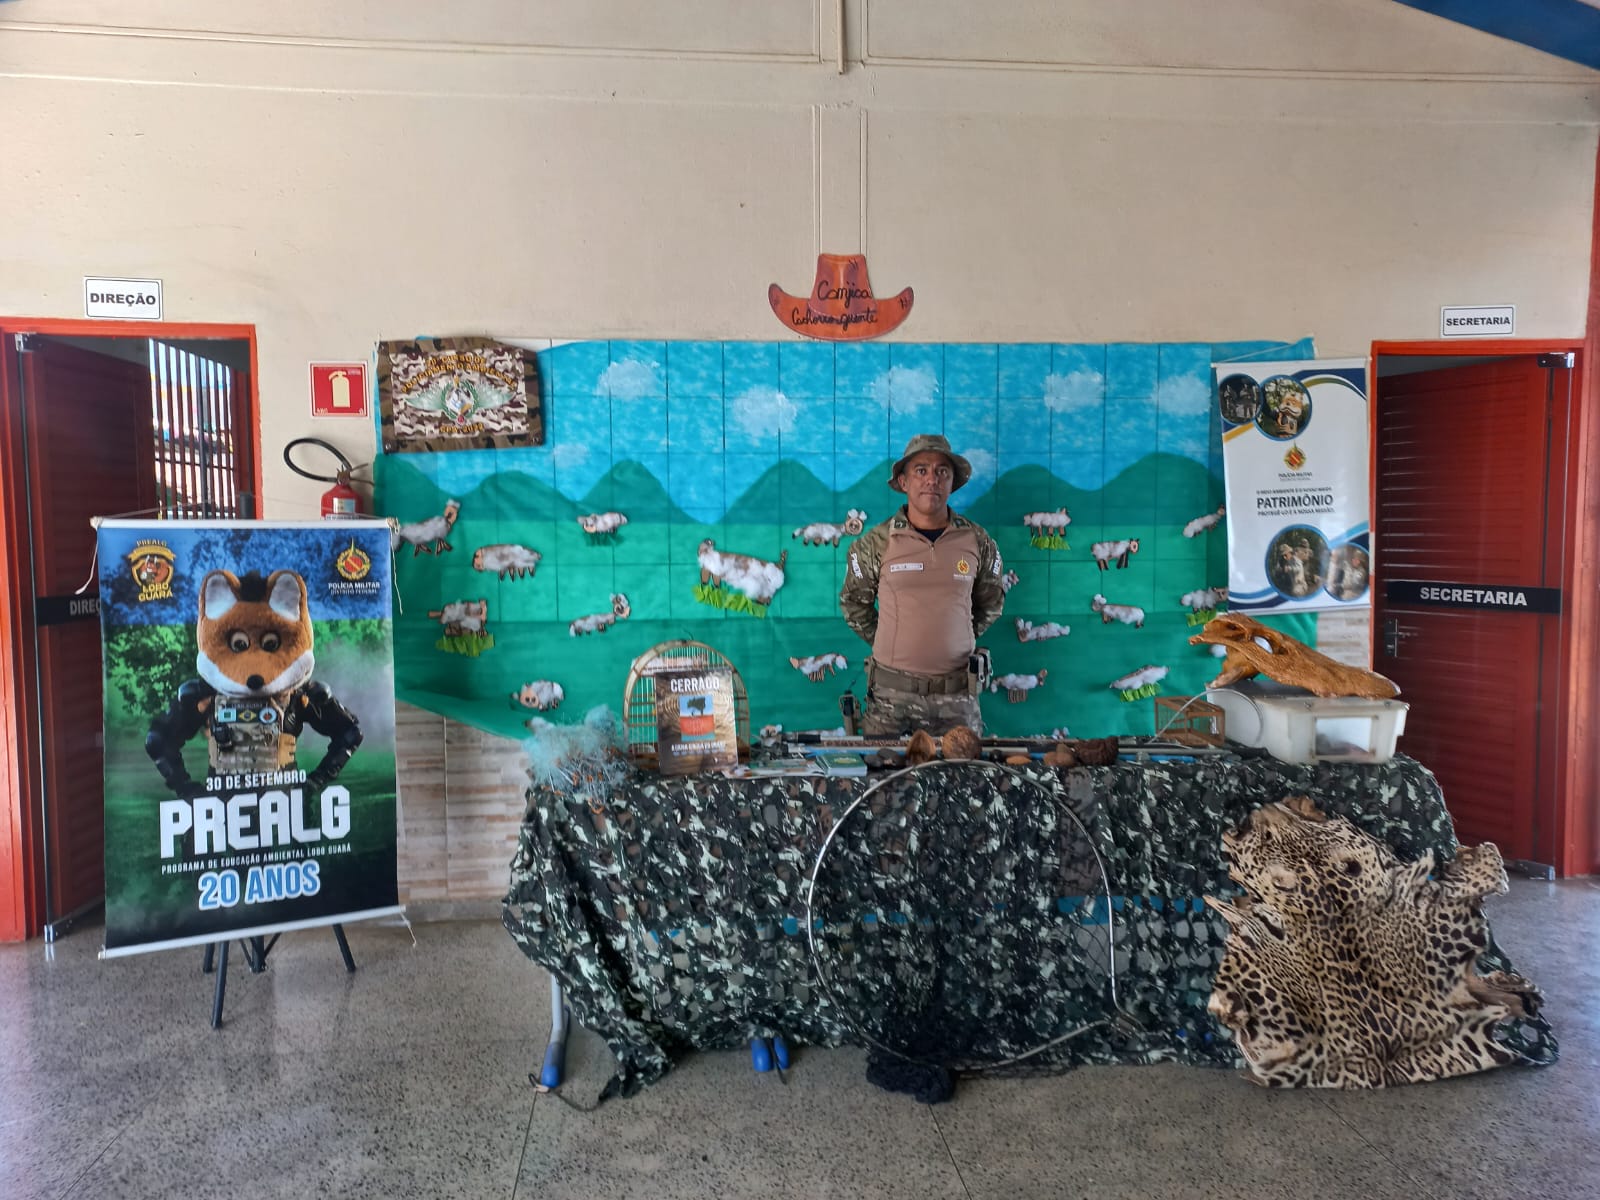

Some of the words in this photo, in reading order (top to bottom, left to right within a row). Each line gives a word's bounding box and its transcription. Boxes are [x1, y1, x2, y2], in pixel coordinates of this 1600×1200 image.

[89, 292, 156, 308] DIREÇÃO
[1445, 316, 1511, 327] SECRETARIA
[1256, 493, 1334, 509] PATRIMÔNIO
[327, 580, 354, 591] POLÍCIA
[354, 580, 380, 590] MILITAR
[1419, 586, 1528, 606] SECRETARIA
[670, 676, 720, 693] CERRADO
[206, 777, 222, 792] 30
[225, 775, 241, 790] DE
[244, 769, 307, 789] SETEMBRO
[159, 784, 351, 859] PREALG
[161, 860, 205, 875] PROGRAMA
[207, 858, 218, 869] DE
[220, 853, 261, 868] EDUCAÇÃO
[263, 848, 305, 863] AMBIENTAL
[307, 846, 326, 857] LOBO
[198, 869, 240, 911] 20
[244, 858, 321, 905] ANOS
